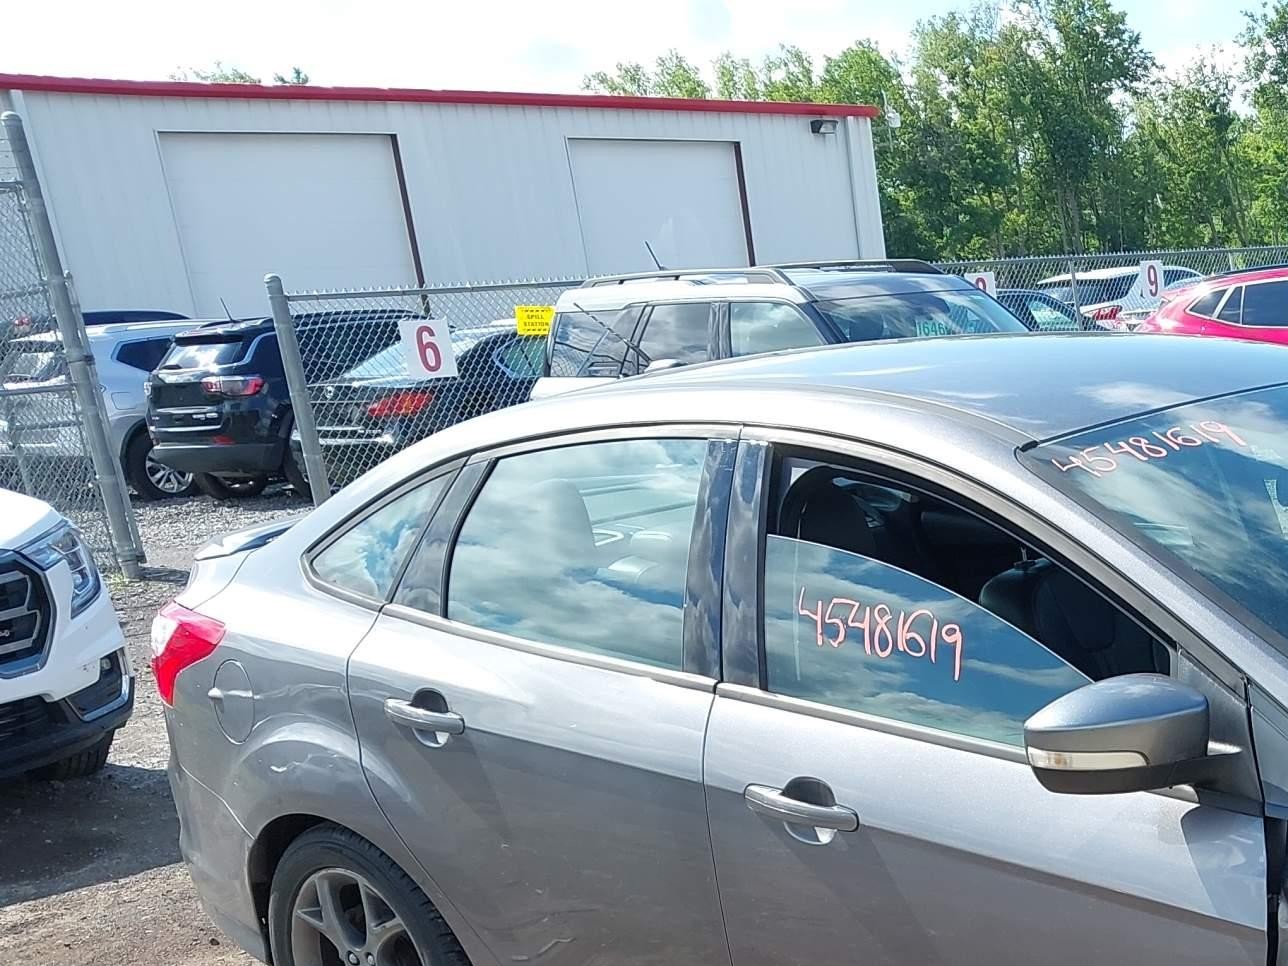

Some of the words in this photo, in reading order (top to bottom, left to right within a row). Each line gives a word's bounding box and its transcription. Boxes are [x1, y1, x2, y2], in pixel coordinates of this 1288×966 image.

[1147, 265, 1158, 297] 9
[416, 325, 441, 372] 6
[1052, 421, 1247, 477] 45481619
[798, 586, 963, 681] 45481619
